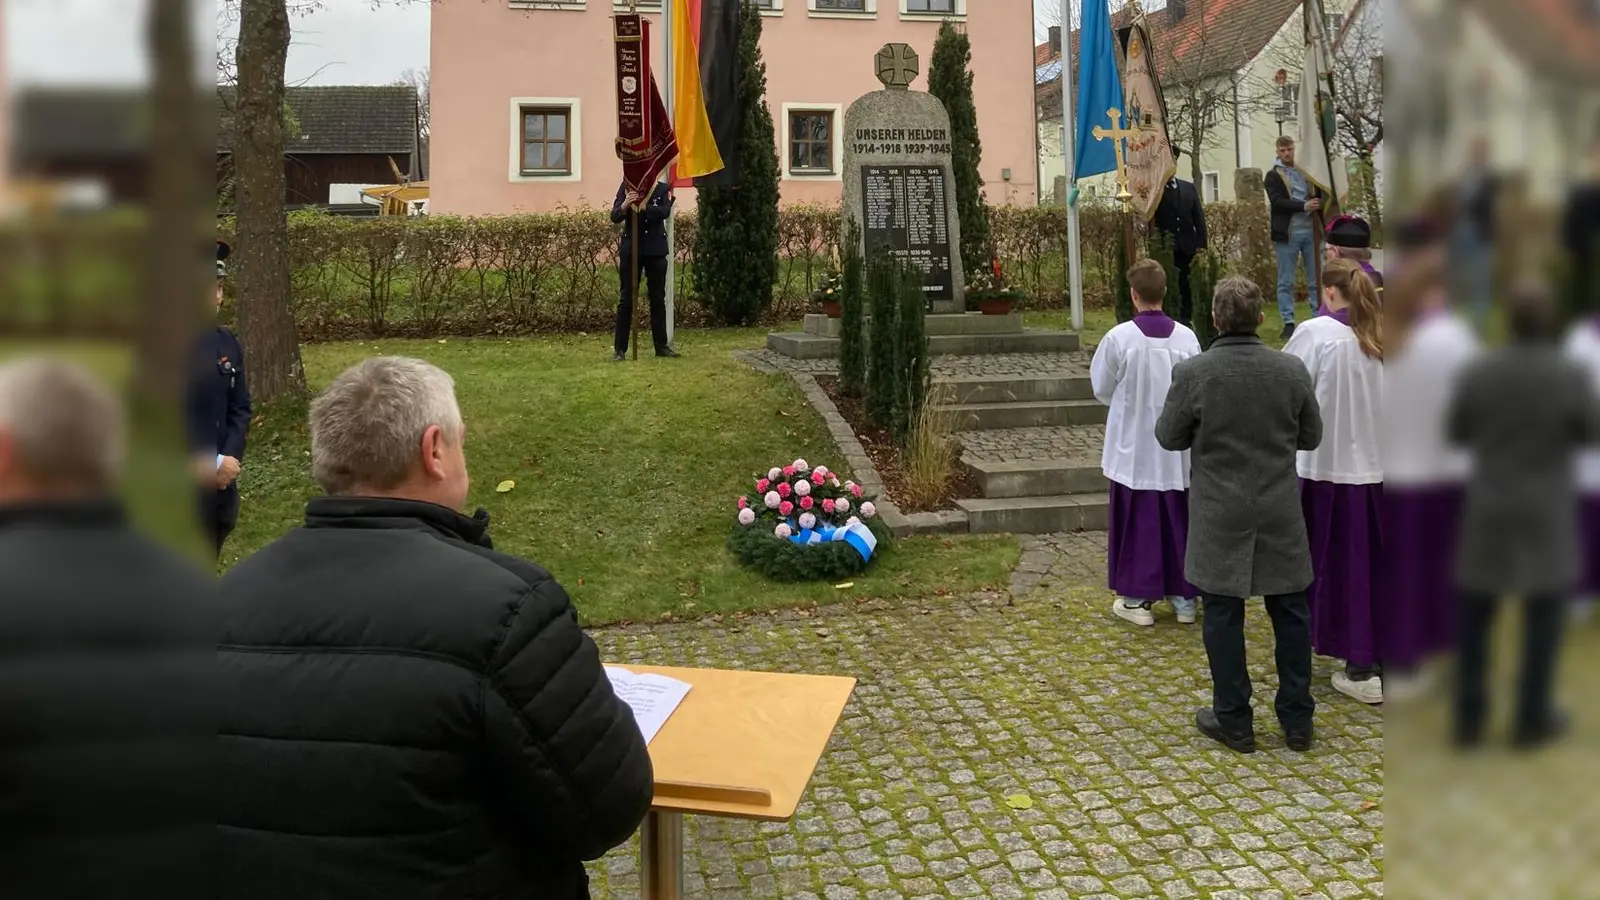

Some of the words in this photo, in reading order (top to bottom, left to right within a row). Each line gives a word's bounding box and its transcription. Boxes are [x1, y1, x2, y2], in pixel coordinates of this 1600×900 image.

[856, 128, 905, 140] UNSEREN
[908, 129, 946, 140] HELDEN
[852, 143, 901, 154] 1914-1918
[904, 143, 951, 154] 1939-1945
